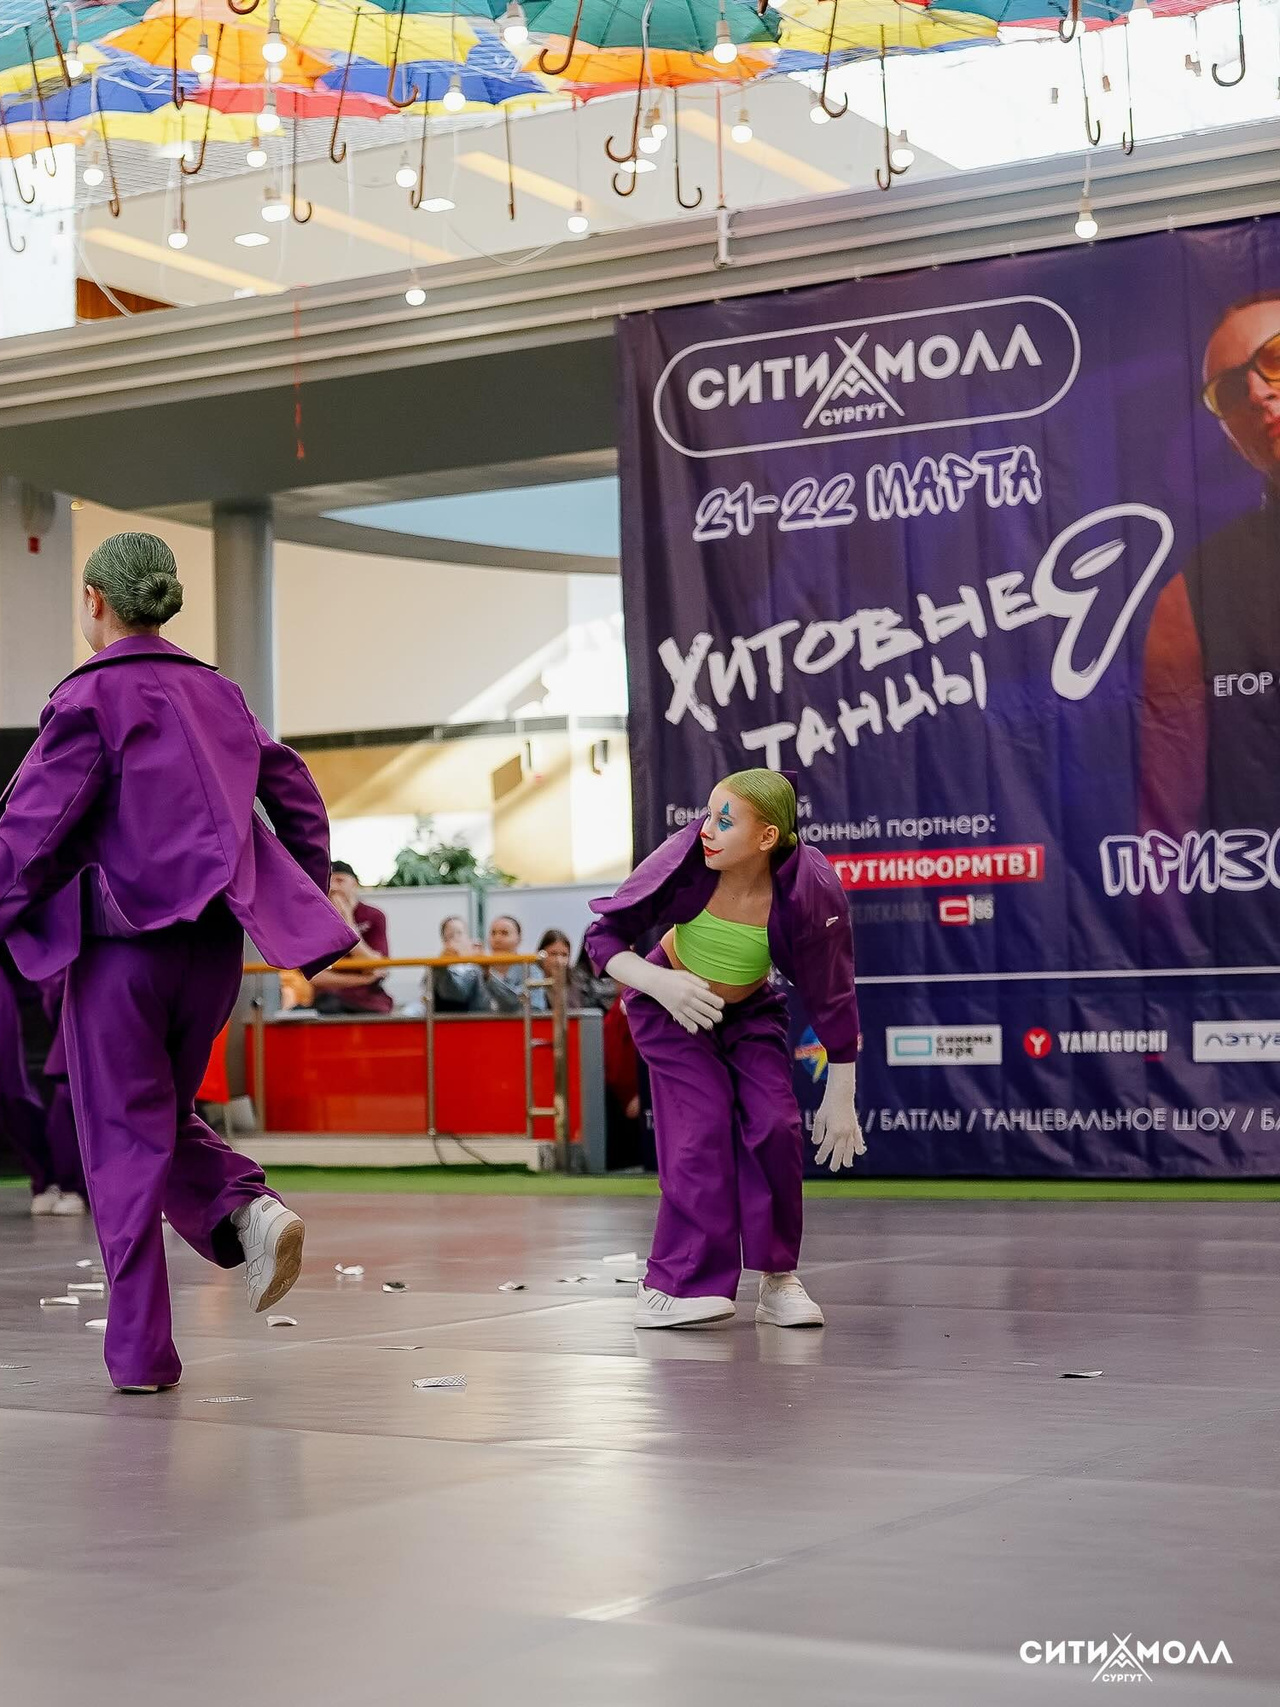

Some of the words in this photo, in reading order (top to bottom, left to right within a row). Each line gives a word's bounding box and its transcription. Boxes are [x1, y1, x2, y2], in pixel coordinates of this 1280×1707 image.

[818, 401, 889, 427] СУРГУТ
[692, 471, 858, 542] 21-22
[865, 444, 1043, 521] МАРТА
[1213, 671, 1274, 697] ЕГОР
[740, 650, 988, 772] ТАНЦЫ
[834, 848, 1038, 884] ГУТИНФОРМТВ]
[1098, 828, 1280, 897] ПРИЗ
[1057, 1030, 1168, 1054] YAMAGUCHI
[880, 1107, 962, 1132] БАТТЛЫ
[981, 1106, 1167, 1133] ТАНЦЕВАЛЬНОЕ
[1172, 1106, 1236, 1132] ШОУ
